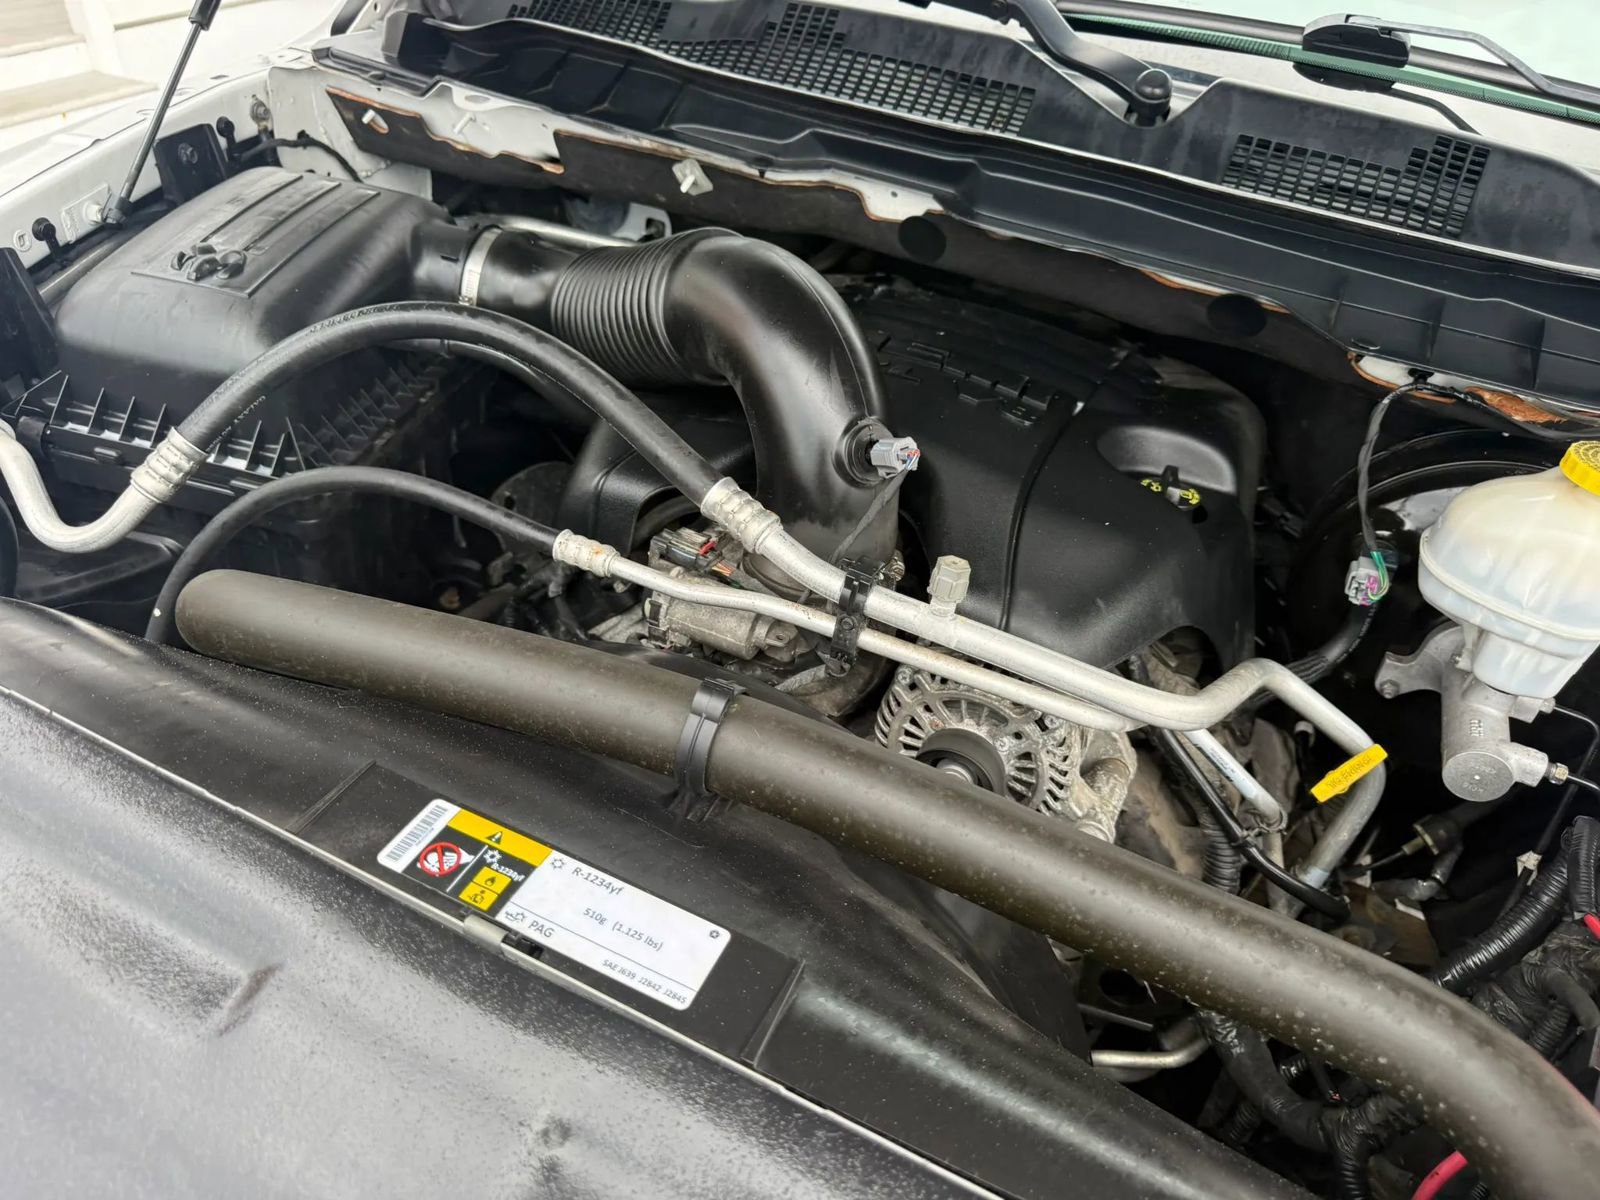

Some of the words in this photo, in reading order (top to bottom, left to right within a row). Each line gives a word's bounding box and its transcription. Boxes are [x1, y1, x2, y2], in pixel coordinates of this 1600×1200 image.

[572, 867, 624, 895] R-1234yf
[528, 920, 556, 938] PAG
[583, 908, 607, 925] 510g
[611, 920, 643, 942] (1.125
[643, 936, 664, 952] lbs)
[602, 959, 618, 972] SAE
[617, 966, 636, 980] J639
[638, 976, 662, 992] J2842
